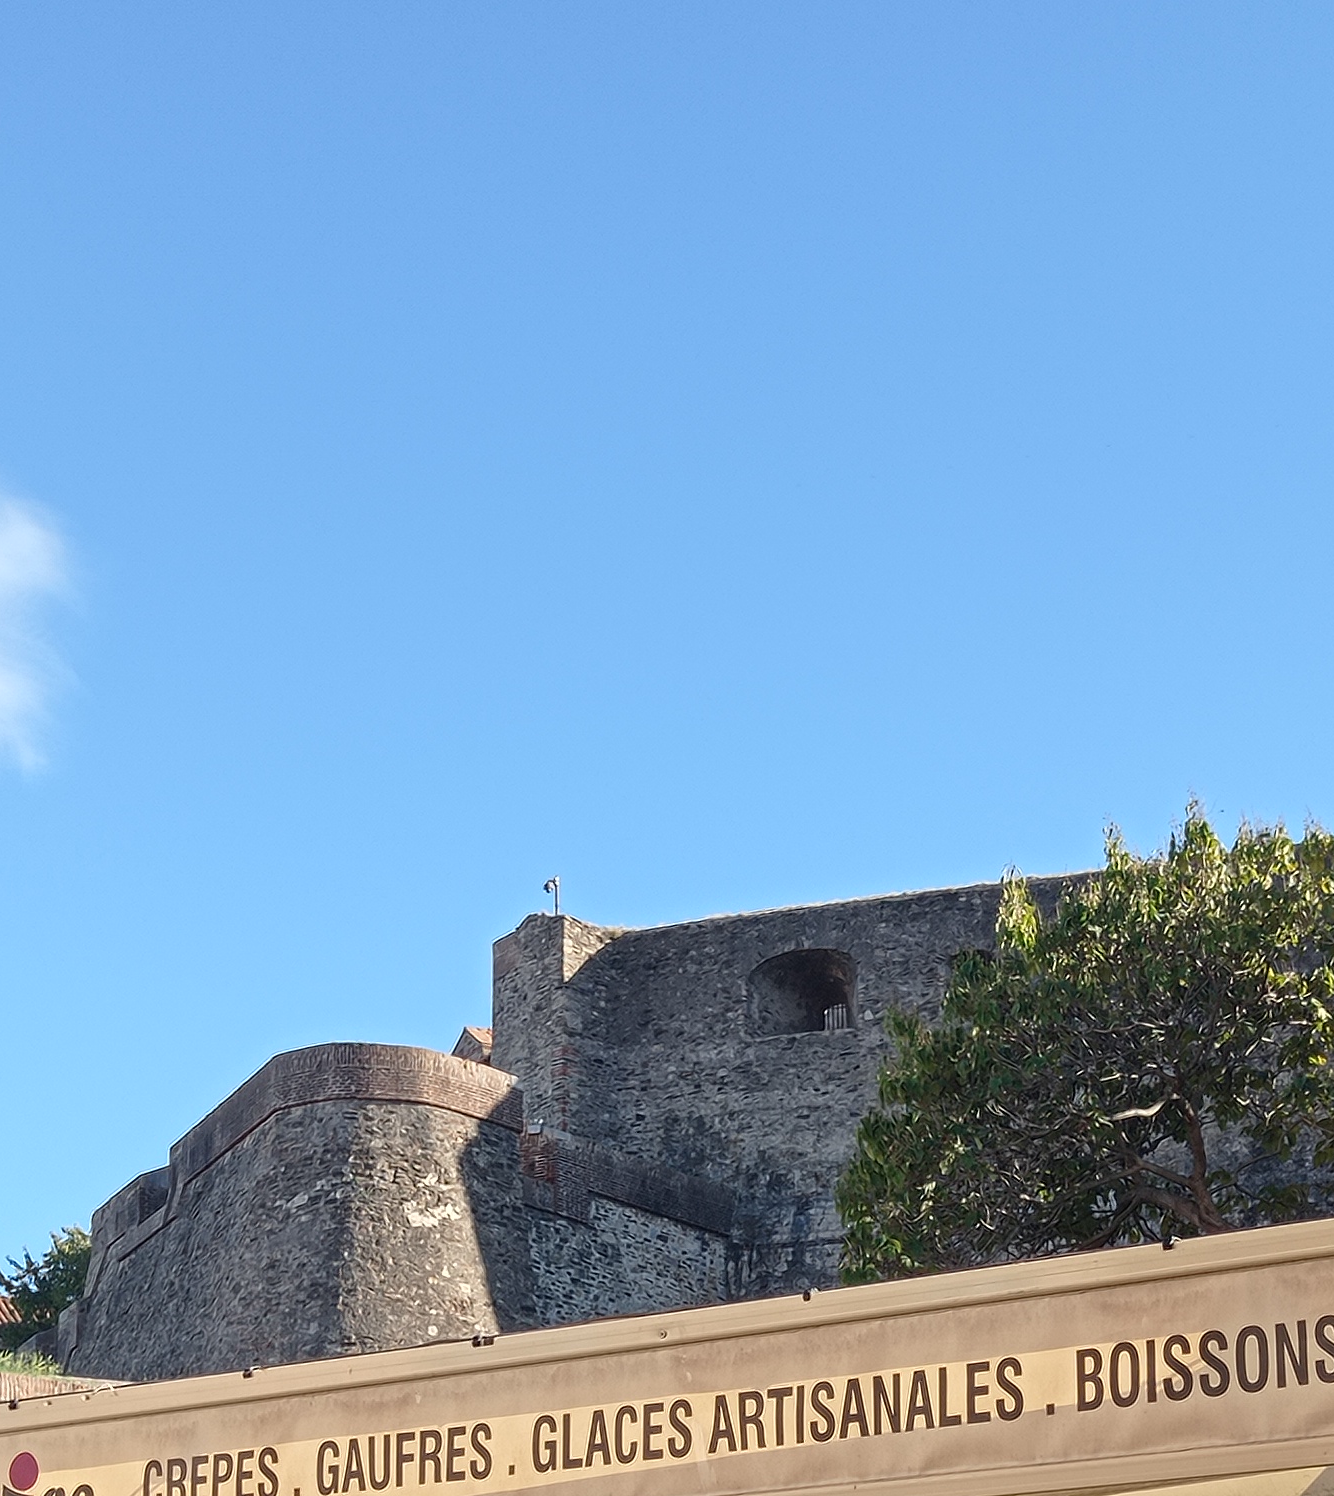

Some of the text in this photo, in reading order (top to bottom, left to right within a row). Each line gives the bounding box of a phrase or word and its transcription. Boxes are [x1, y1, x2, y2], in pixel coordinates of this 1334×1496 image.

[316, 1422, 493, 1496] GAUFRES
[532, 1398, 693, 1475] GLACES
[708, 1356, 1023, 1455] ARTISANALES
